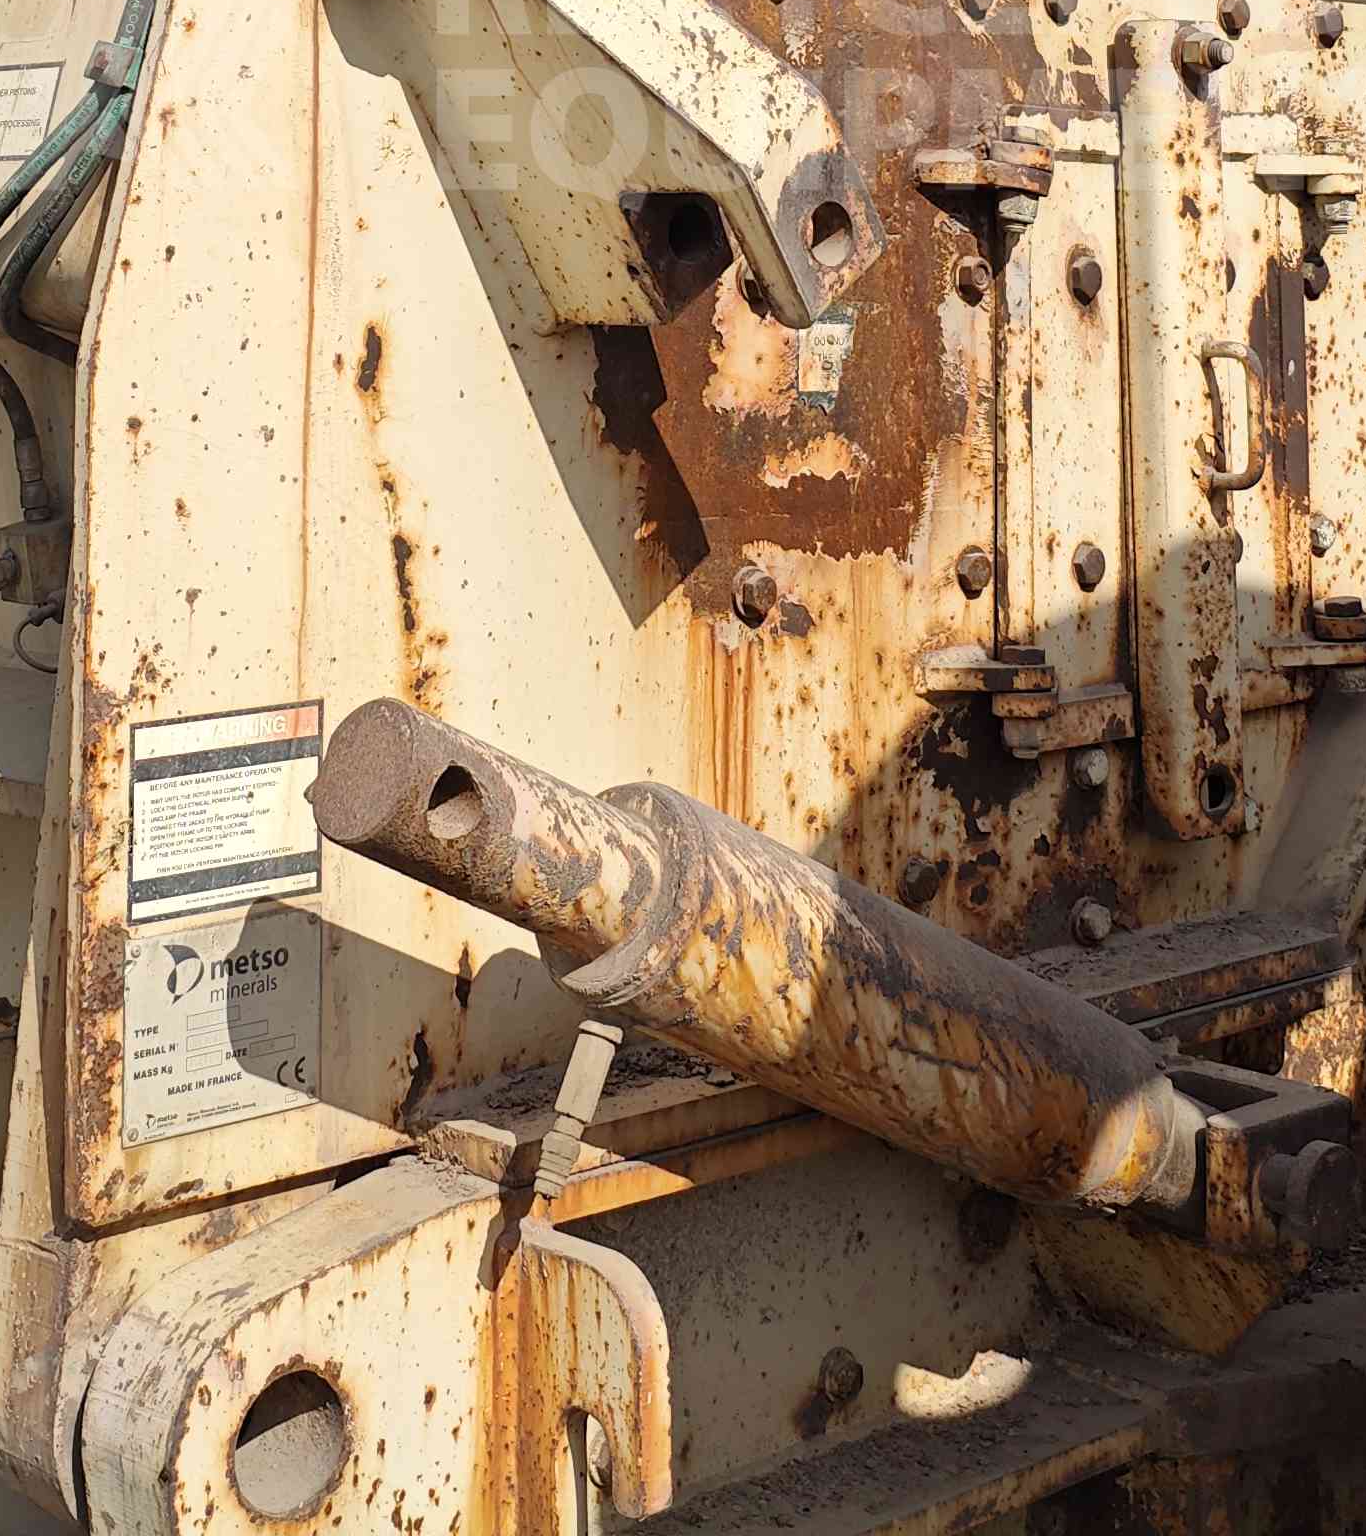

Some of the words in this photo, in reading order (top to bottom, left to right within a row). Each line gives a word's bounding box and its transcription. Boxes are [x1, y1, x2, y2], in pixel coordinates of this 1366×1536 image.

[210, 947, 289, 980] metso
[210, 973, 278, 1003] minerals
[134, 1025, 159, 1039] TYPE
[133, 1046, 166, 1060] SERIAL
[133, 1067, 159, 1081] MASS
[160, 1065, 173, 1075] Kg
[225, 1047, 248, 1061] DATE
[167, 1082, 193, 1096] MADE
[194, 1080, 205, 1090] IN
[207, 1071, 243, 1087] FRANCE
